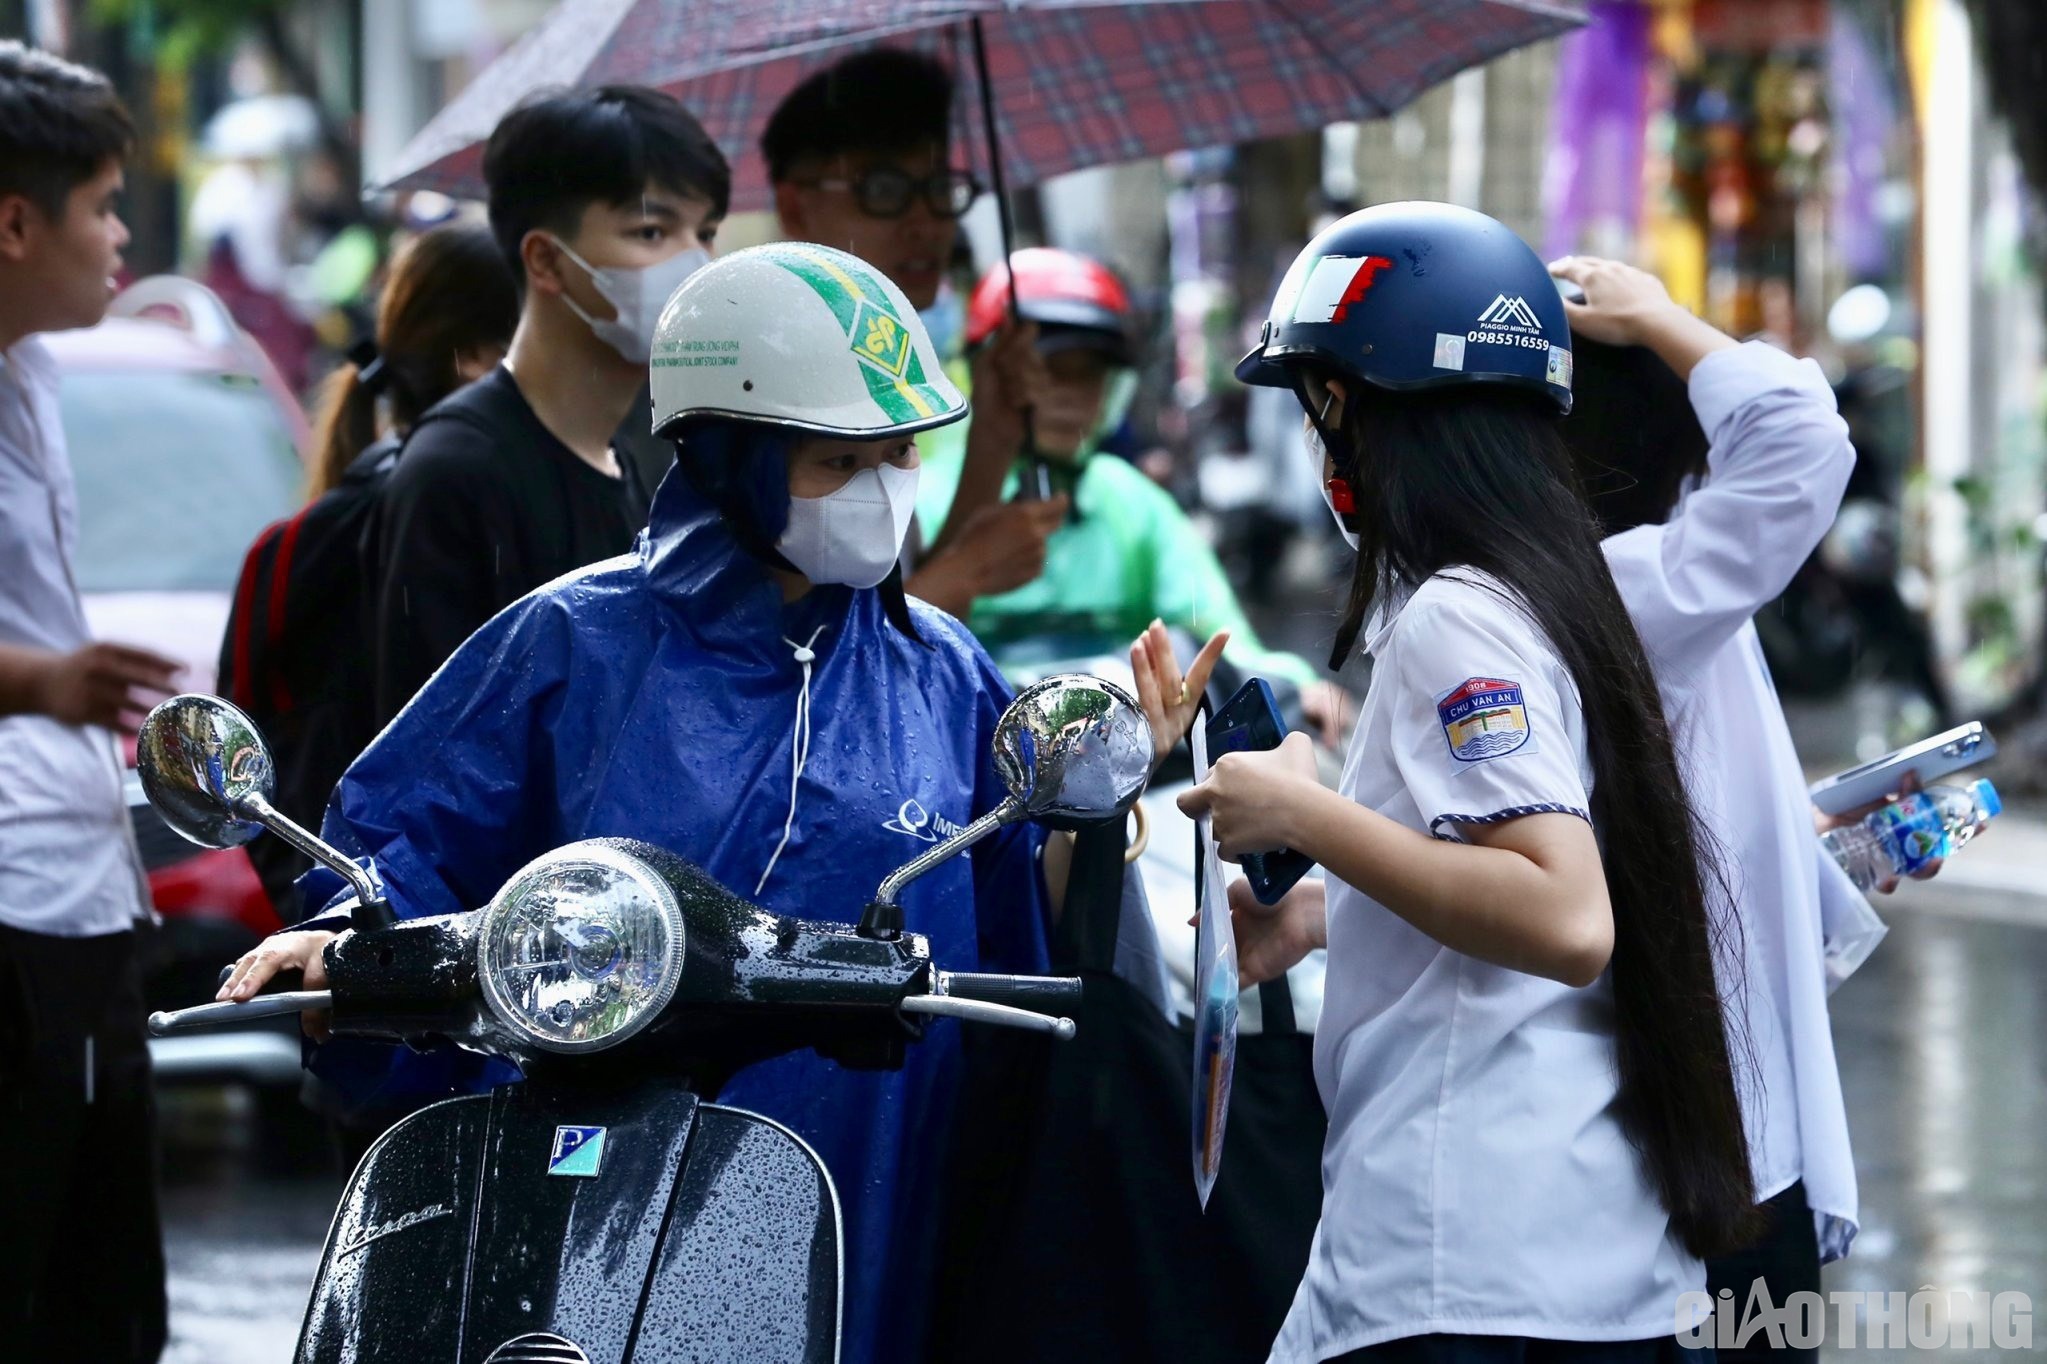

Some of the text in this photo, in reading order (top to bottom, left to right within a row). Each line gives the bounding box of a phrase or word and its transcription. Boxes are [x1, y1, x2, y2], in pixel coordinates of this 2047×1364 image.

[1480, 322, 1540, 335] PIAGGIO MINH TÂM
[1467, 330, 1550, 351] 0985516559
[1465, 682, 1487, 693] 1908
[1450, 692, 1513, 718] CHU VAN AN
[553, 1128, 584, 1159] P
